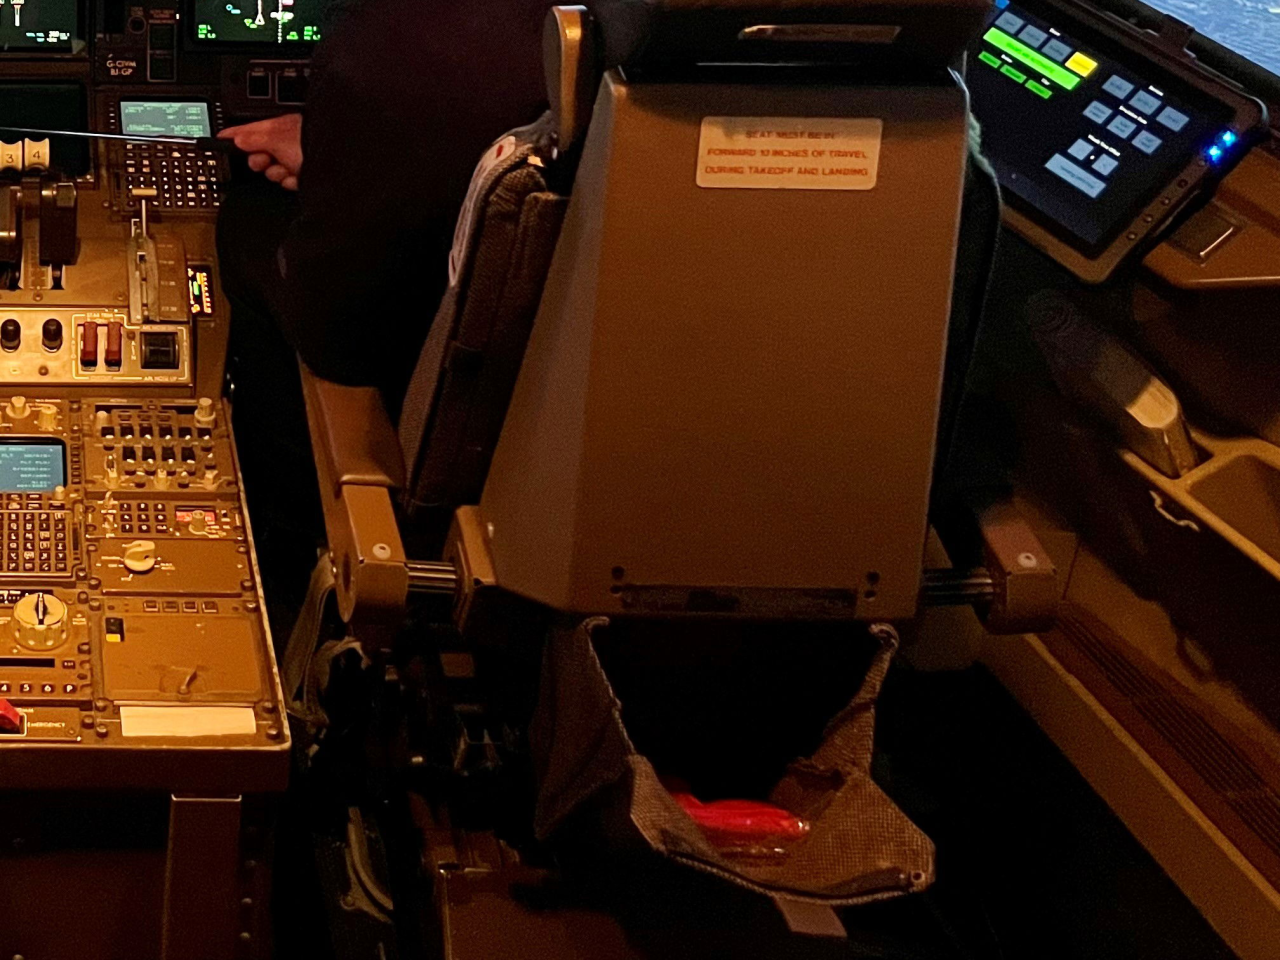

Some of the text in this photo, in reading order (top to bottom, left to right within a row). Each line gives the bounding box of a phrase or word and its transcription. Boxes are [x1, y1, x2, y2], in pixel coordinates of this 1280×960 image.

[6, 153, 14, 164] 3
[32, 150, 41, 160] 4
[707, 148, 756, 156] FORWARD
[771, 149, 808, 157] INCHES
[829, 150, 867, 159] TRAVEL
[705, 166, 868, 176] DURING TAKEOFF AND LANDING
